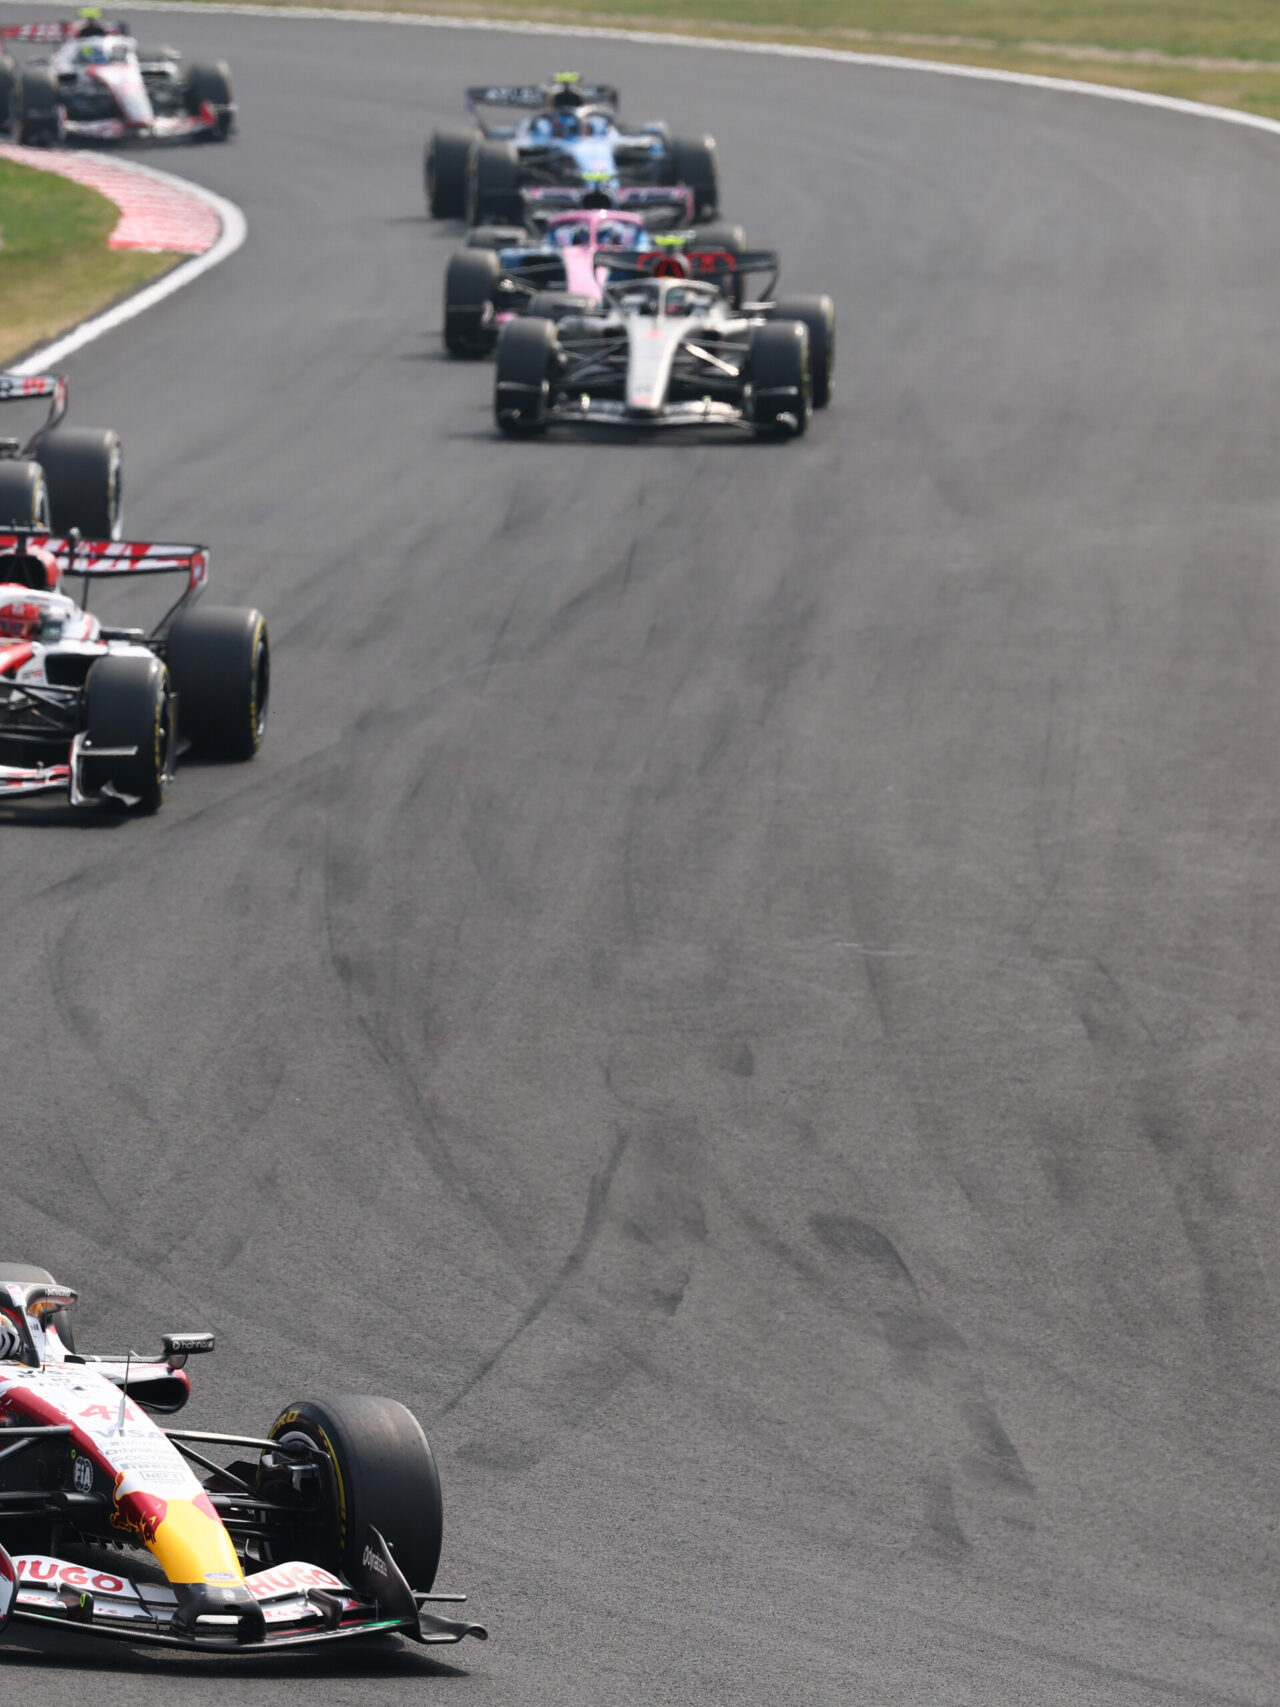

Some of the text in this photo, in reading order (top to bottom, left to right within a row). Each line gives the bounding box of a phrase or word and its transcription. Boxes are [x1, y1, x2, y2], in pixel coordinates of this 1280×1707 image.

[90, 1429, 167, 1440] VISA
[74, 1463, 93, 1488] FIA
[248, 1568, 341, 1597] HUGO
